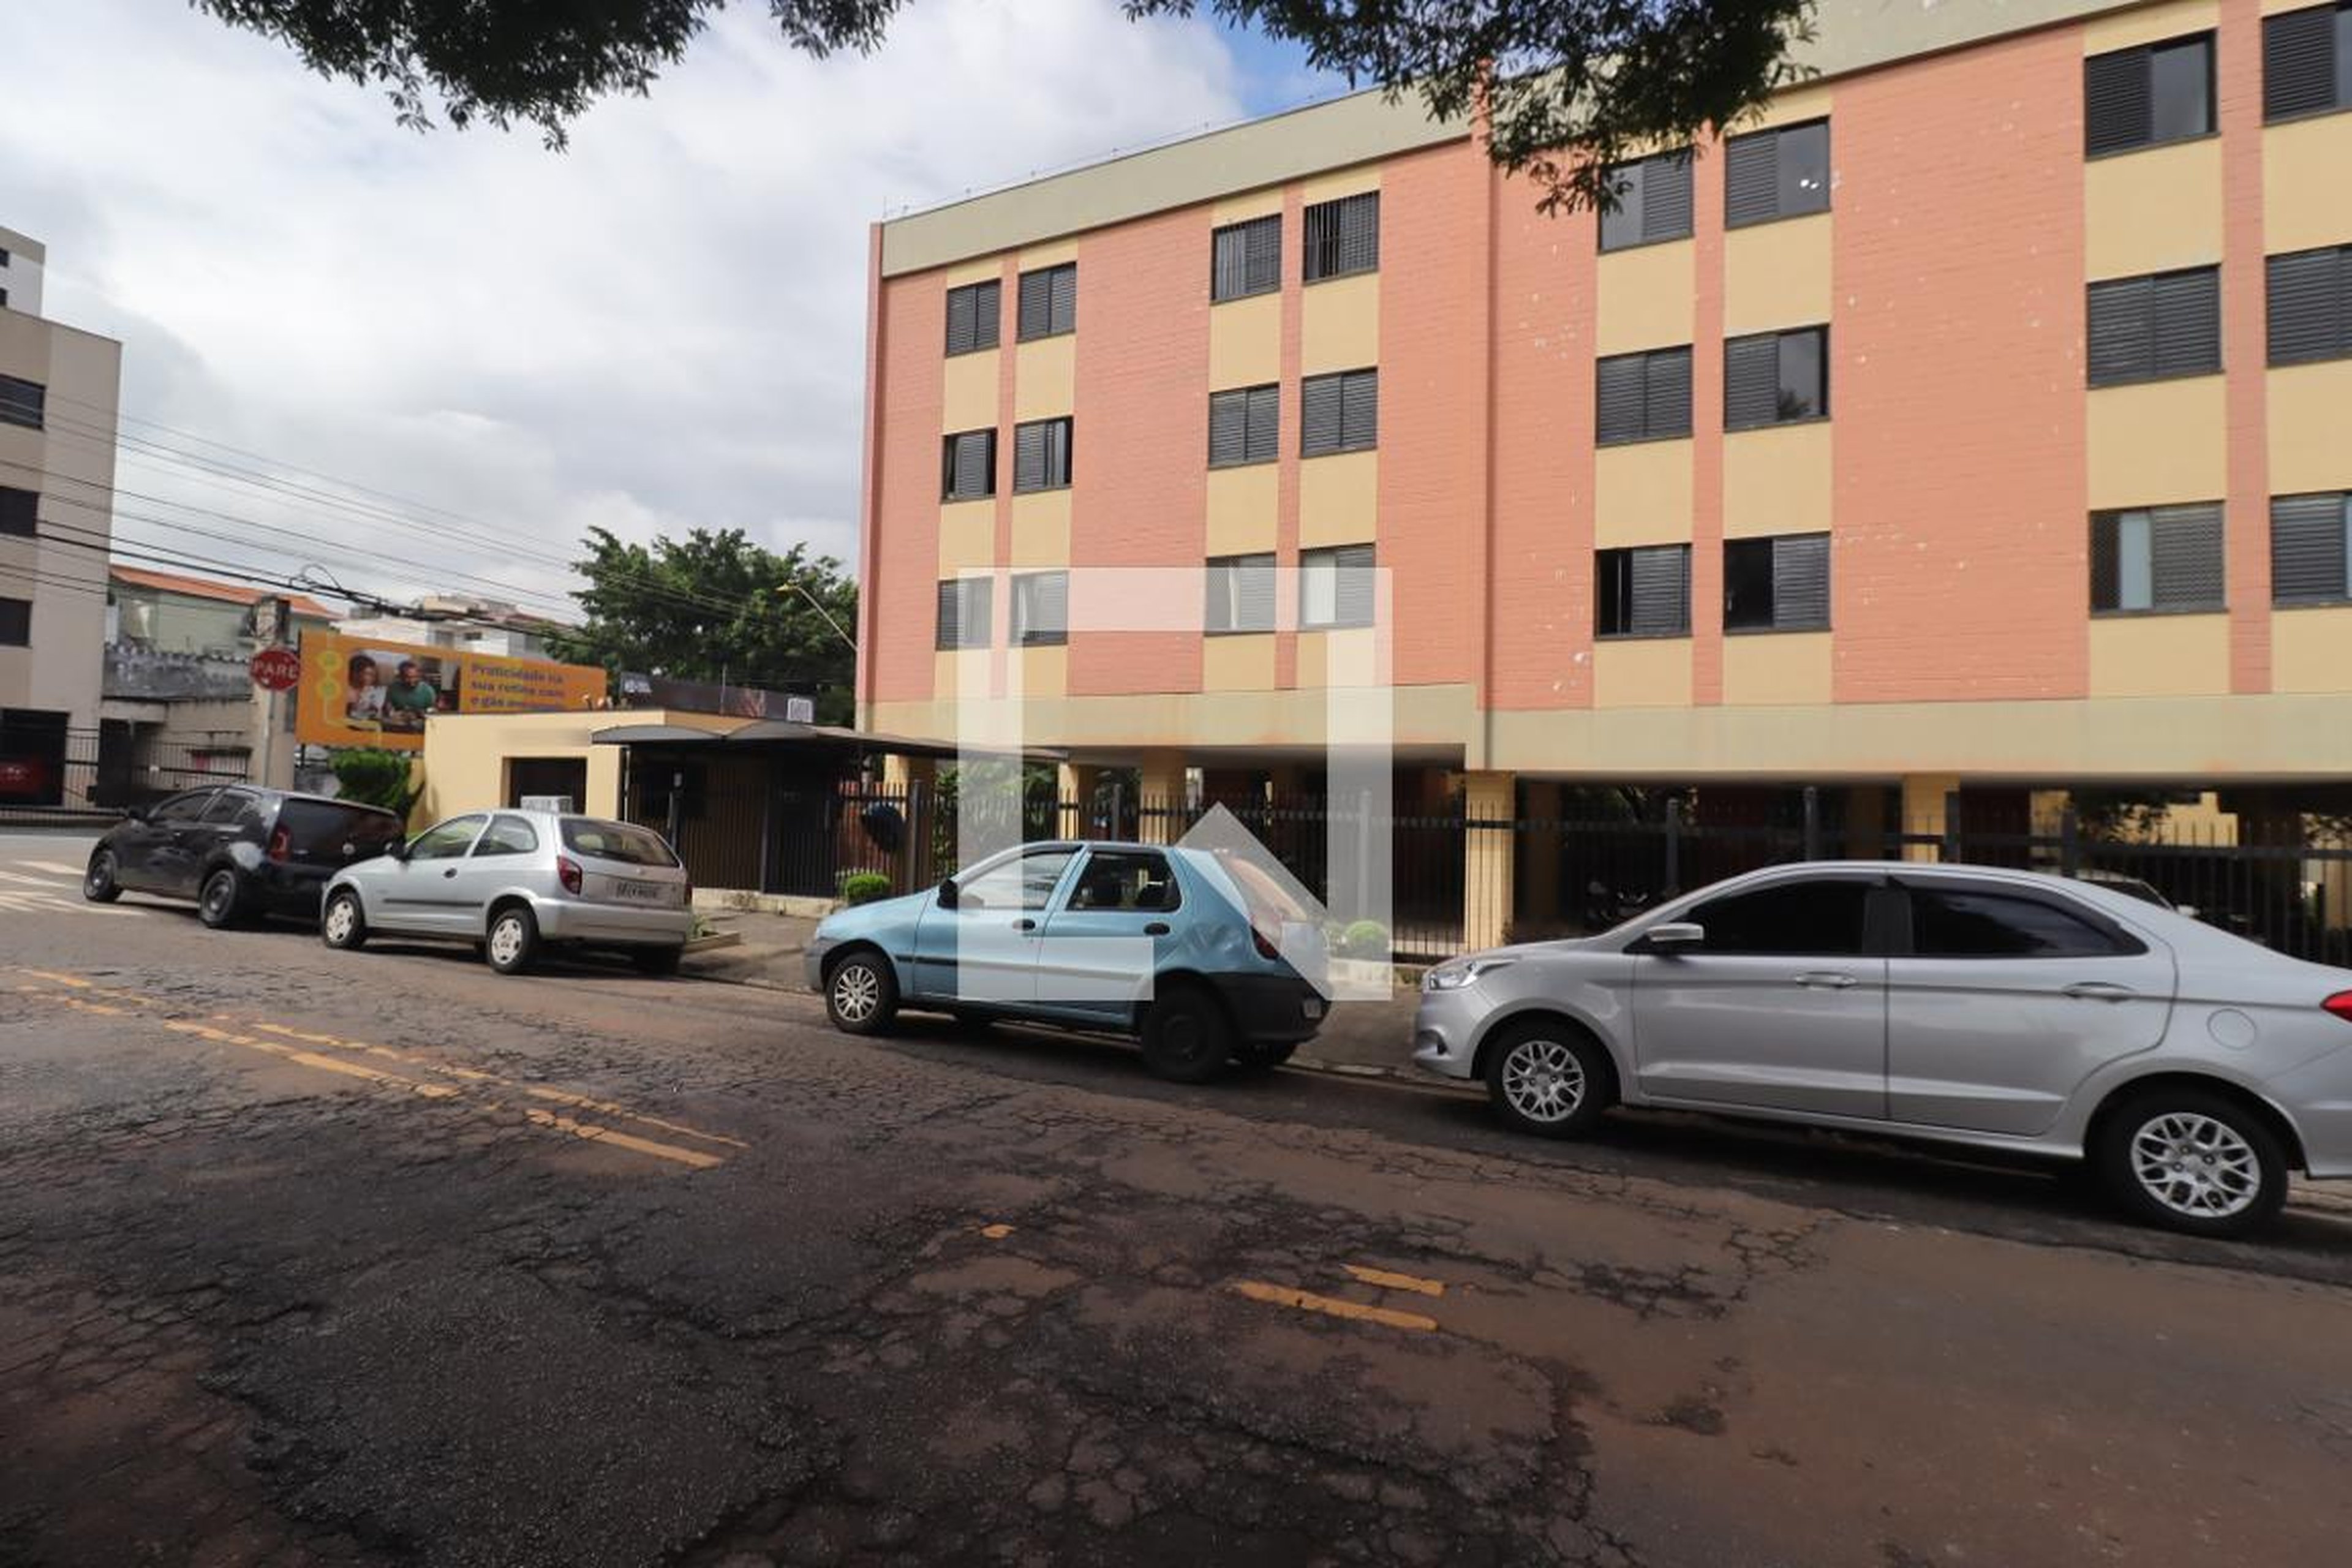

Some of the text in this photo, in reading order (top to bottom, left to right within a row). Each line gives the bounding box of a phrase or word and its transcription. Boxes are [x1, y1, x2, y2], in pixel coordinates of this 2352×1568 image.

[253, 660, 298, 679] PARE
[470, 663, 546, 682] Praticidade
[470, 680, 494, 692] sua
